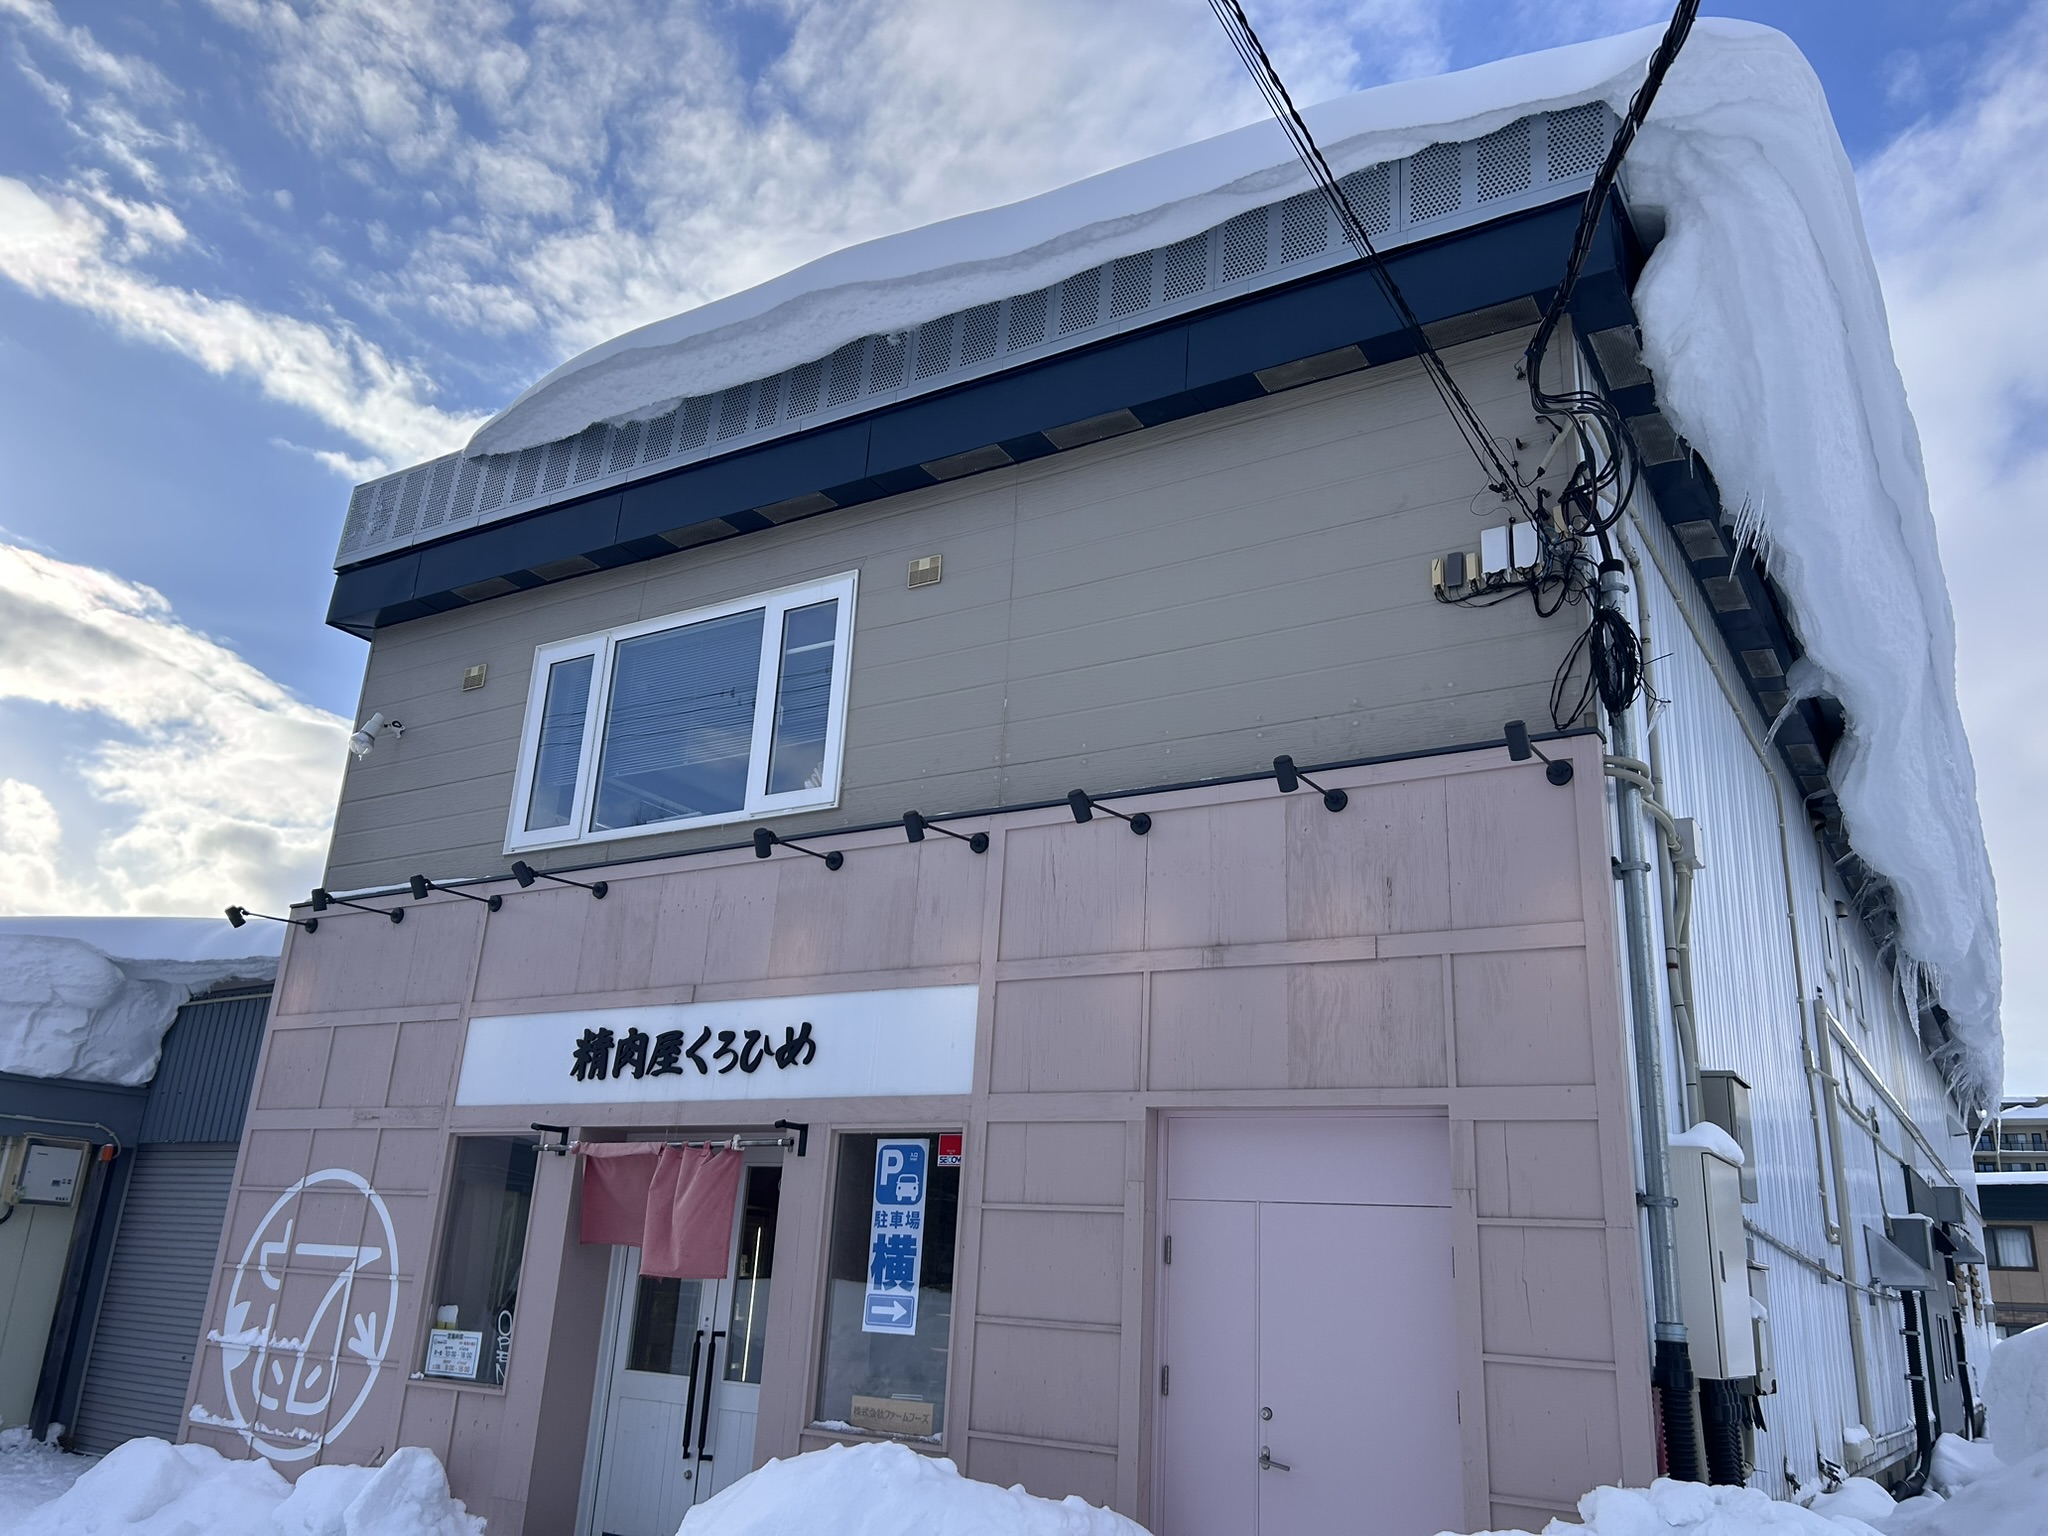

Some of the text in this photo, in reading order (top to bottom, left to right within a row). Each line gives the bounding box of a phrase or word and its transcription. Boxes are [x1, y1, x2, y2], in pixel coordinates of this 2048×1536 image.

[569, 1021, 817, 1082] 精肉屋くろひめ
[880, 1149, 904, 1186] P
[874, 1210, 921, 1230] 駐車場
[870, 1233, 918, 1293] 横
[853, 1406, 930, 1424] 株式会社ファームフーズ
